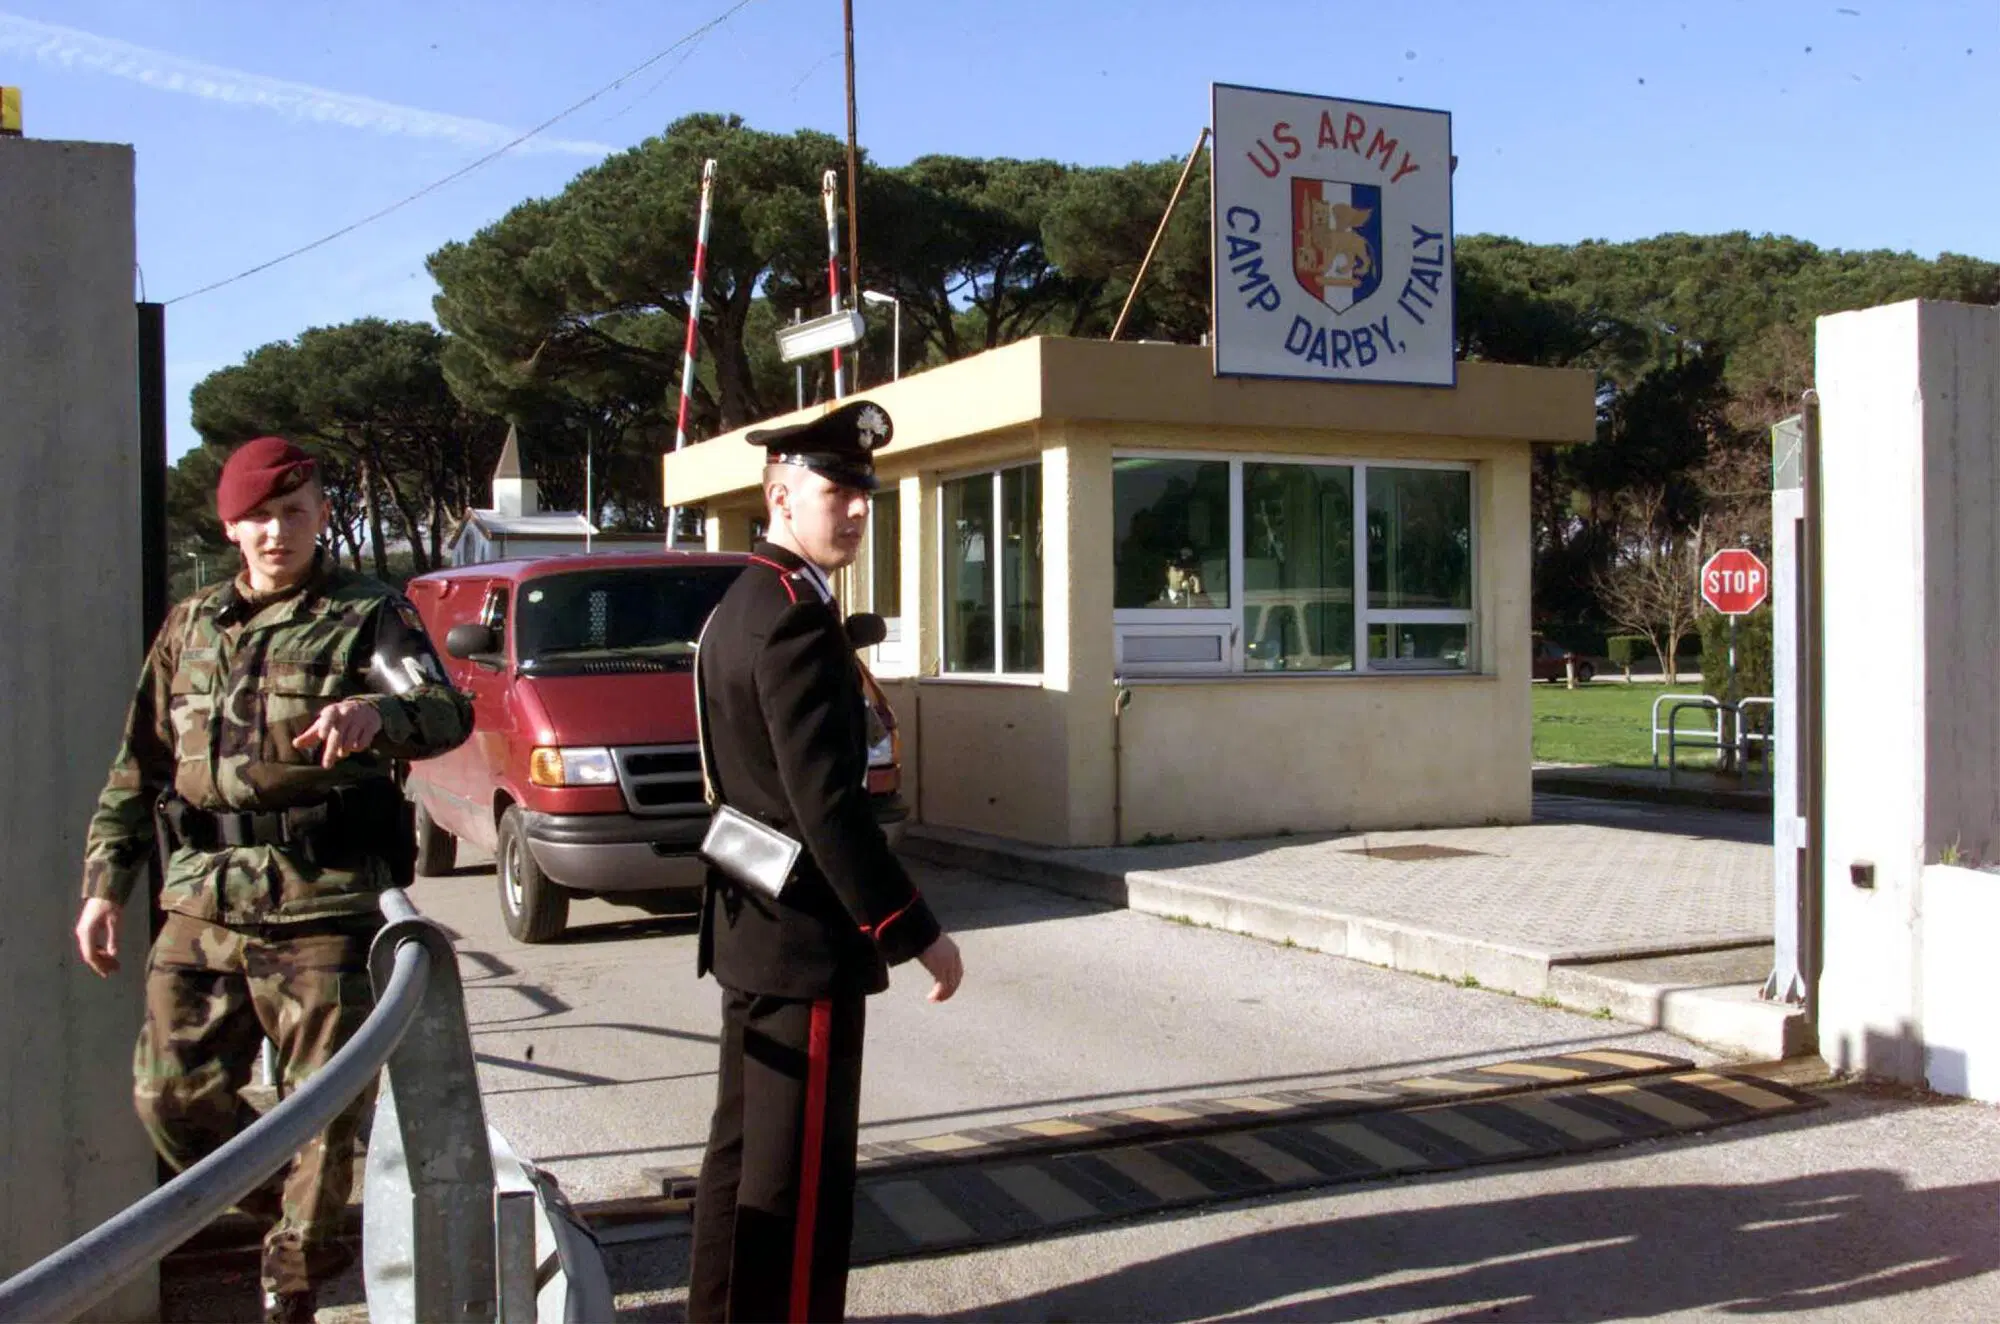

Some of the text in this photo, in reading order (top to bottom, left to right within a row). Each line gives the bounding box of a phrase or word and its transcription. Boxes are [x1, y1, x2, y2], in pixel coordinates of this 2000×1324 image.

[1247, 109, 1420, 183] US ARMY
[1225, 205, 1444, 368] CAMP DARBY, ITALY
[1708, 569, 1760, 593] STOP
